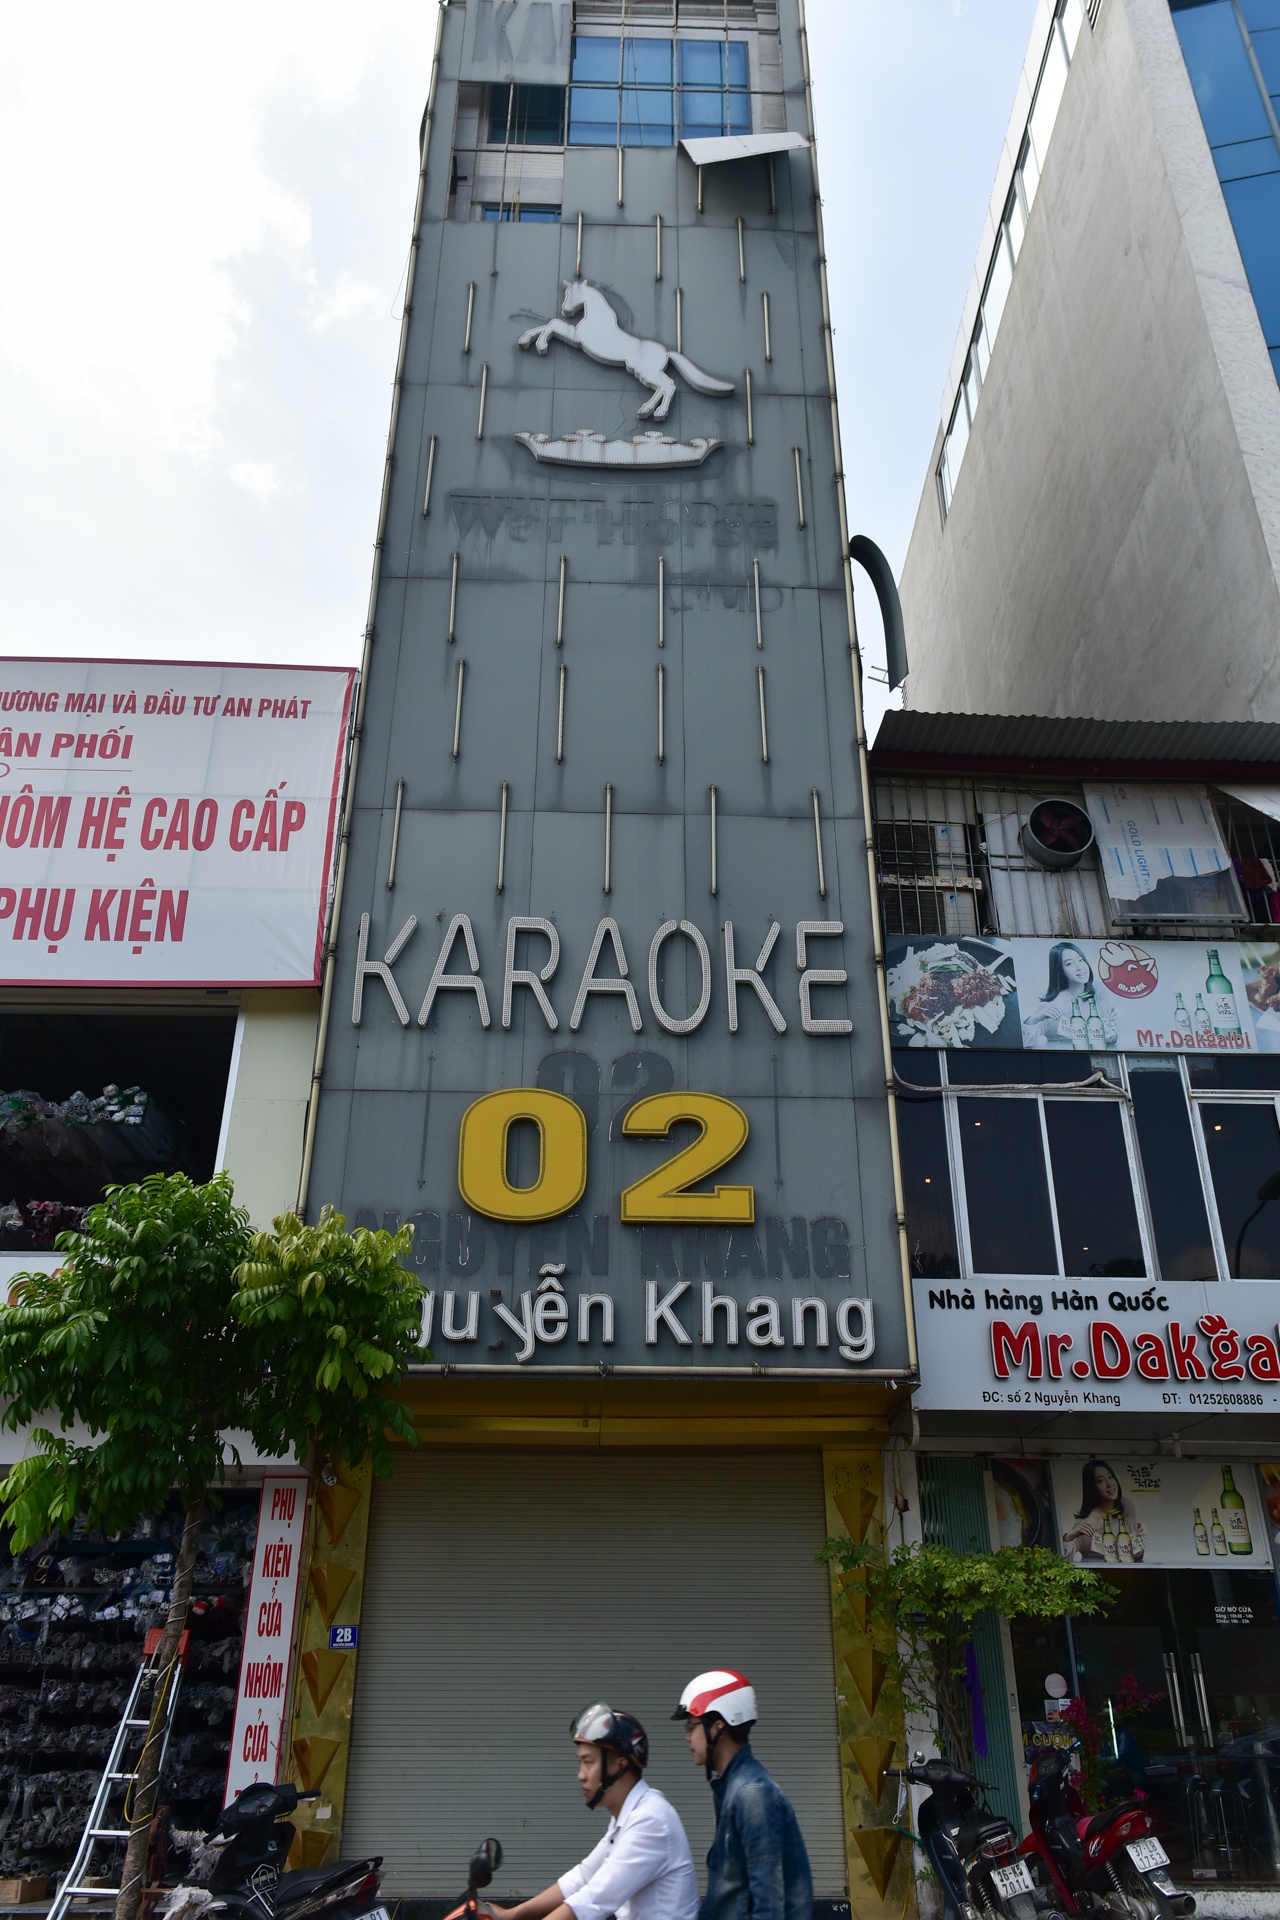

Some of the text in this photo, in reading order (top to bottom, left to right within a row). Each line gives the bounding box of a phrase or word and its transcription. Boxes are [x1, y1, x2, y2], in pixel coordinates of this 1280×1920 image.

[472, 1, 570, 65] KA
[64, 693, 106, 717] MẠI
[112, 690, 137, 714] VÀ
[144, 689, 185, 715] ĐẦU
[193, 694, 221, 716] TƯ
[222, 698, 251, 718] AN
[257, 695, 311, 719] PHÁT
[50, 725, 133, 759] PHỐI
[77, 785, 132, 862] HỆ
[140, 797, 218, 851] CAO
[229, 781, 306, 852] CẤP
[1126, 819, 1142, 847] GOLD
[1134, 849, 1151, 878] LIGHT
[0, 878, 189, 954] PHỤ KIỆN
[352, 912, 853, 1036] KARAOKE
[1136, 1029, 1252, 1049] Mr.Dakgalbi
[458, 1088, 755, 1225] 02
[402, 1263, 876, 1364] guyễn Khang
[929, 1287, 1169, 1315] Nhà hàng Hàn Quốc
[990, 1313, 1280, 1381] Mr.Dakga
[982, 1389, 1121, 1407] ĐC: số 2 Nguyễn Khang
[1162, 1393, 1182, 1405] ĐT:
[1189, 1393, 1264, 1406] 01252608886
[271, 1487, 297, 1528] PHỤ
[261, 1538, 293, 1586] KIỆN
[257, 1587, 283, 1637] CỬA
[336, 1628, 352, 1642] 2B
[244, 1658, 284, 1698] NHÔM
[242, 1708, 269, 1763] CỬA
